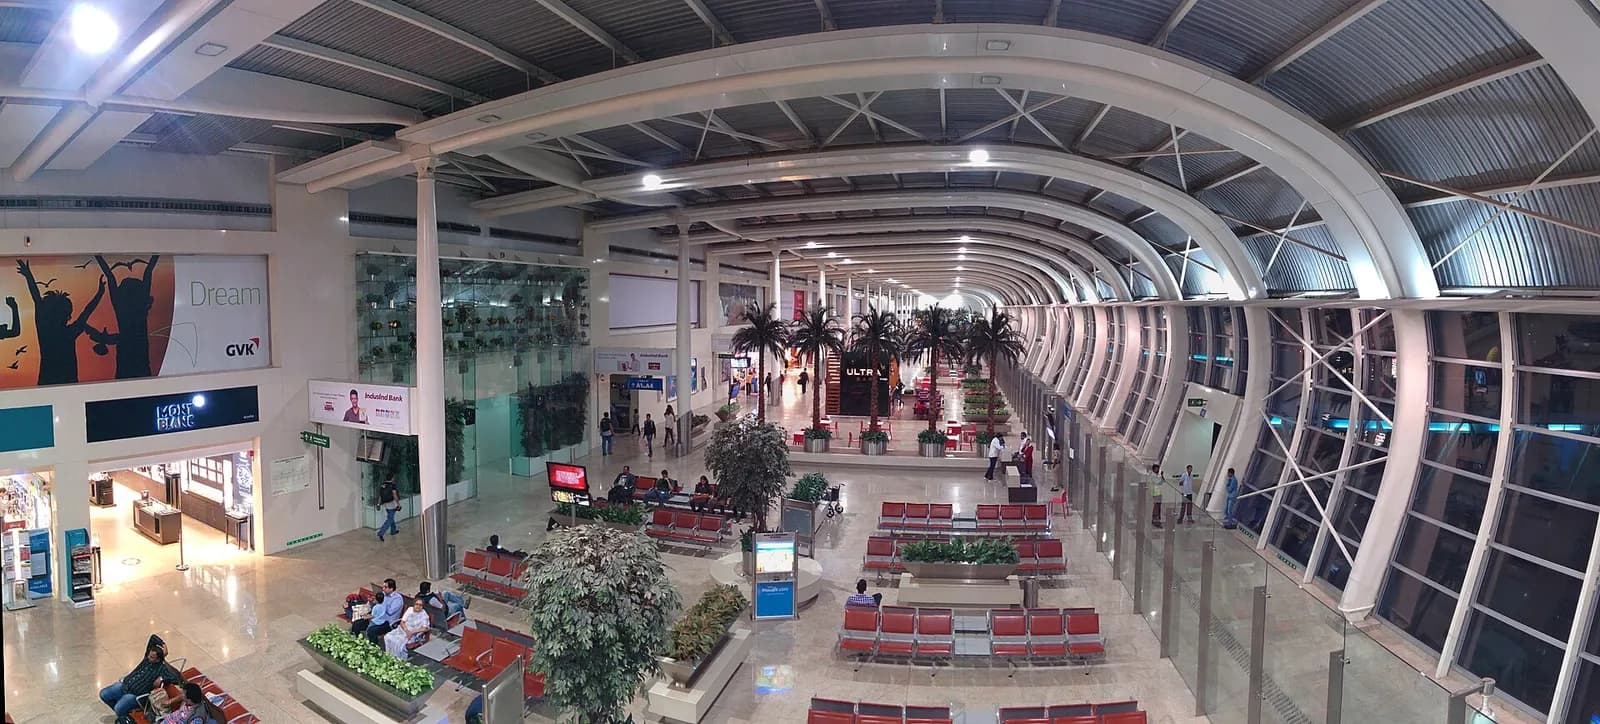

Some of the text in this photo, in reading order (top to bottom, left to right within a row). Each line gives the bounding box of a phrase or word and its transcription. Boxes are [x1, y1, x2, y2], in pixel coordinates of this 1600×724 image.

[190, 281, 261, 306] Dream
[226, 343, 255, 357] GVK
[846, 368, 882, 376] ULTRA
[364, 392, 403, 402] IndusInd Bank
[156, 402, 193, 418] MONT
